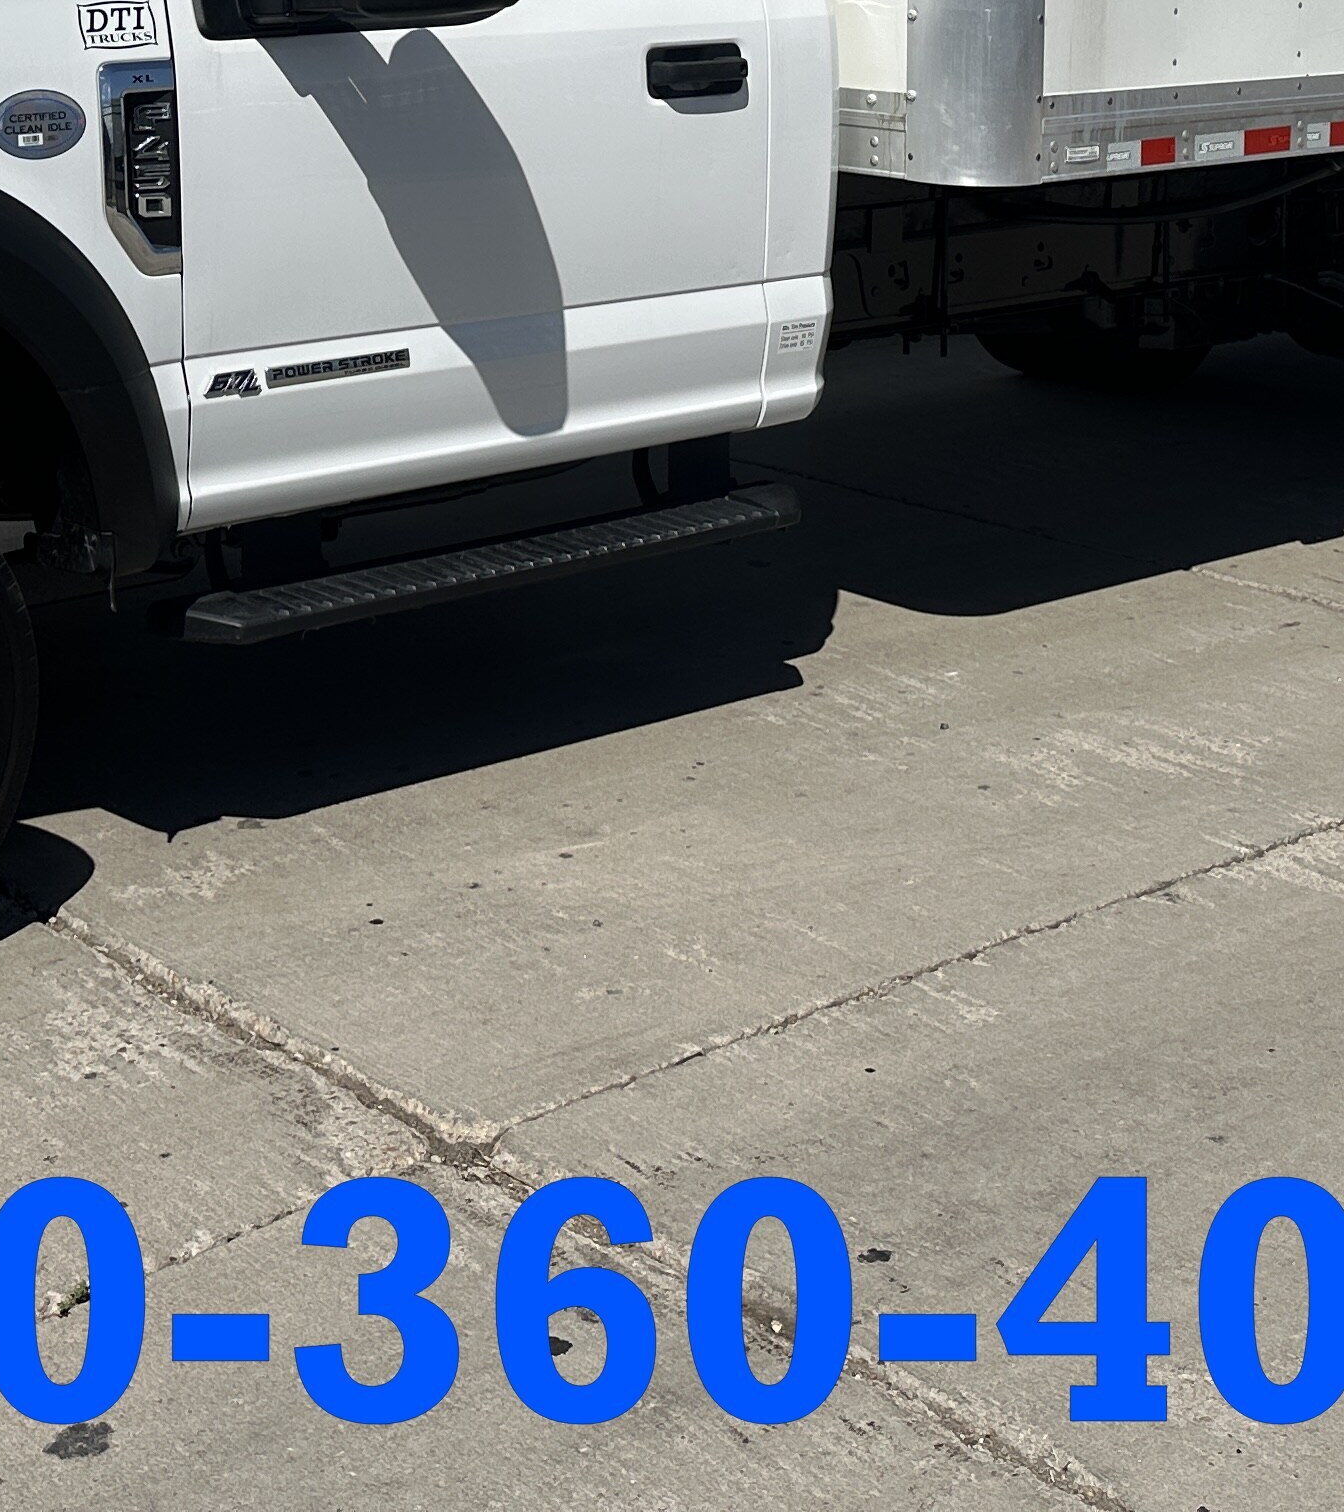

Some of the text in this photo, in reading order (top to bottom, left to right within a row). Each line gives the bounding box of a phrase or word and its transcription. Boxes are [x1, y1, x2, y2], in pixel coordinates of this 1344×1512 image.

[86, 6, 145, 33] DTI
[87, 31, 153, 44] TRUCKS
[132, 74, 154, 83] XL
[9, 111, 67, 123] CERTIFIED
[4, 121, 73, 135] CLEAN IDLE
[273, 361, 333, 380] POWER
[338, 350, 406, 370] STROKE
